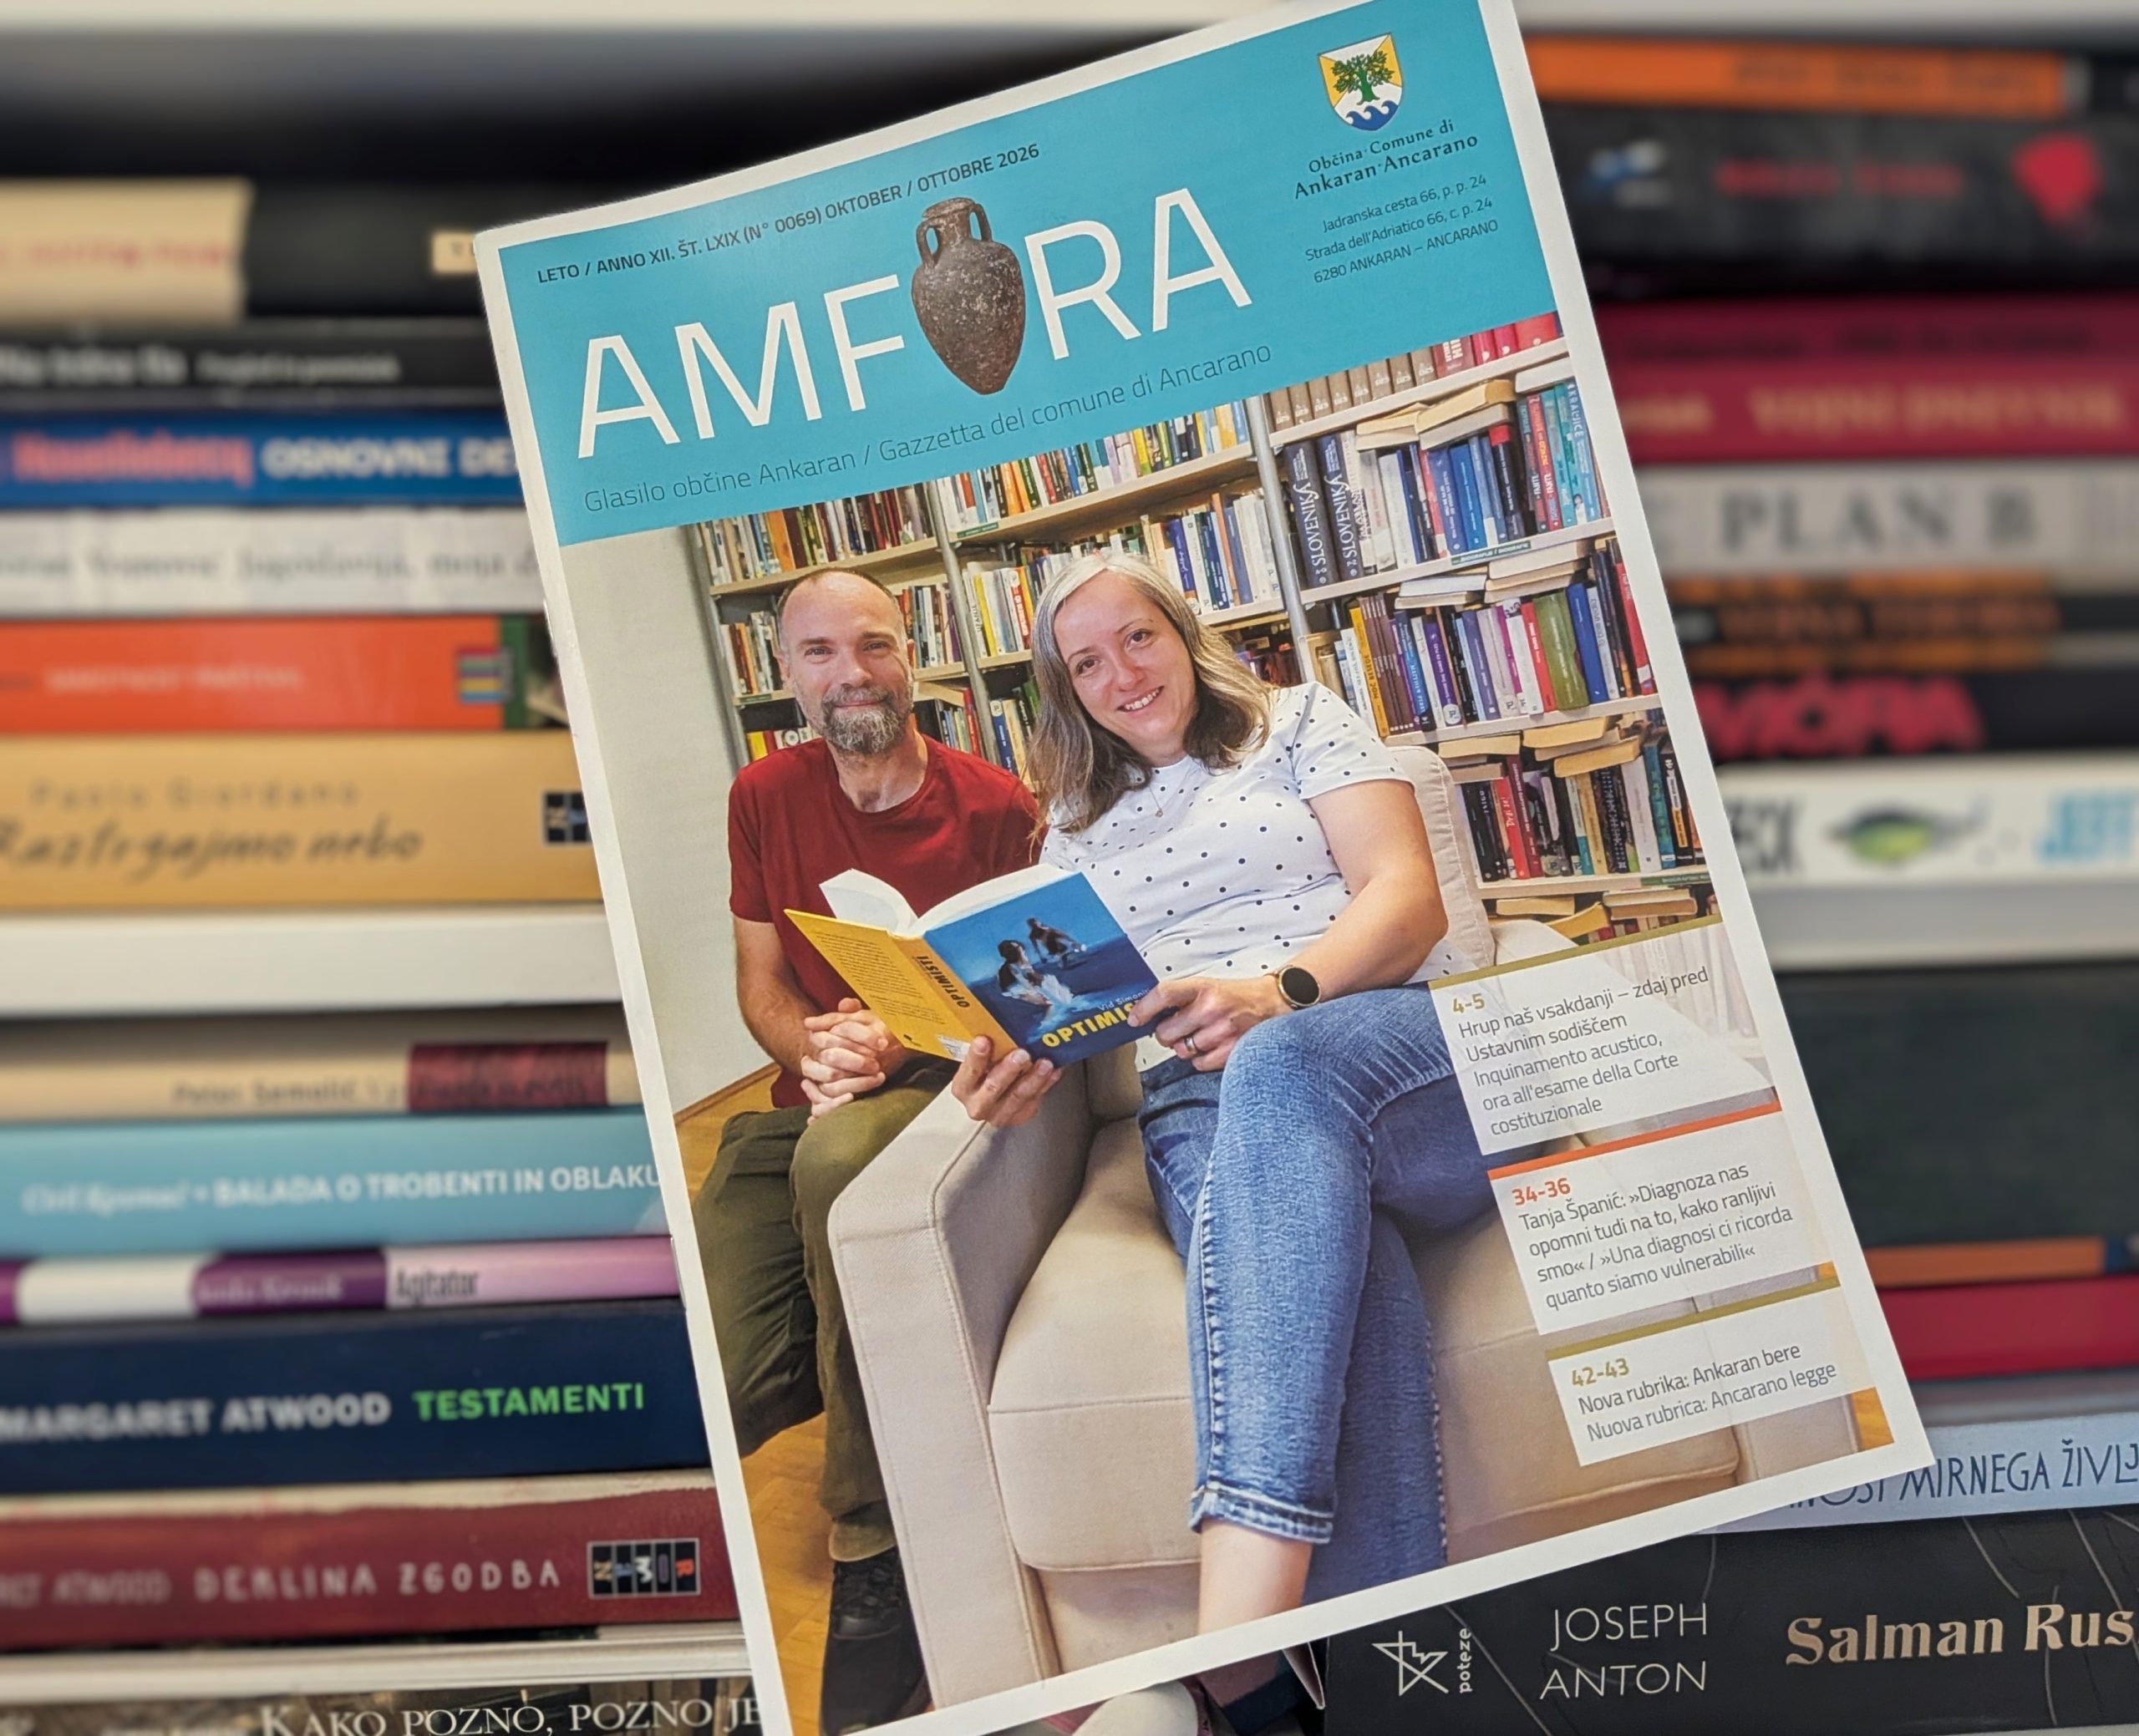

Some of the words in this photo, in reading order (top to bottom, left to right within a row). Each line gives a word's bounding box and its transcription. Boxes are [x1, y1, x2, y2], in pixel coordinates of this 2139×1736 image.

[1439, 119, 1455, 135] di
[537, 264, 580, 284] LETO
[585, 261, 592, 277] /
[597, 253, 646, 274] ANNO
[650, 247, 676, 265] XII.
[678, 239, 703, 258] ŠT.
[705, 231, 741, 252] LXIX
[775, 206, 822, 233] 0069)
[825, 185, 902, 220] OKTOBER
[907, 180, 913, 197] /
[917, 156, 995, 192] OTTOBRE
[998, 143, 1040, 168] 2026
[1304, 240, 1346, 261] Strada
[1348, 218, 1425, 250] dell'Adriatico
[1426, 211, 1448, 226] 66,
[1450, 208, 1461, 221] c.
[1461, 205, 1475, 219] p.
[1476, 196, 1493, 212] 24
[1323, 206, 1383, 233] Jadranska
[1385, 195, 1418, 215] cesta
[1420, 187, 1441, 203] 66,
[1442, 186, 1455, 201] p.
[1456, 182, 1469, 196] p.
[1469, 174, 1487, 189] 24
[1313, 264, 1347, 284] 6280
[1349, 244, 1412, 274] ANKARAN
[1426, 219, 1499, 251] ANCARANO
[578, 188, 1252, 459] AMFRA
[584, 482, 666, 512] Glasilo
[673, 470, 752, 499] občine
[759, 449, 856, 485] Ankaran
[864, 444, 871, 466] /
[879, 418, 986, 463] Gazzetta
[990, 407, 1026, 436] del
[1032, 385, 1125, 424] comune
[1131, 373, 1152, 399] di
[1160, 343, 1272, 393] Ancarano
[1293, 482, 1327, 566] SLOVENIKA
[1324, 474, 1358, 560] SLOVENIKA
[917, 955, 971, 1008] OPTIMISTI
[1452, 992, 1486, 1014] 4-5
[1458, 1017, 1501, 1039] Hrup
[1503, 1007, 1534, 1030] naš
[1537, 989, 1614, 1022] vsakdanji
[1633, 976, 1669, 999] zdaj
[1670, 966, 1710, 994] pred
[1041, 1002, 1135, 1048] OPTIMIS
[1465, 1031, 1547, 1063] Ustavnim
[1548, 1013, 1628, 1045] sodiščem
[1473, 1047, 1588, 1088] Inquinamento
[1590, 1033, 1664, 1060] acustico,
[1482, 1094, 1512, 1112] ora
[1513, 1075, 1590, 1105] all'esame
[1592, 1063, 1632, 1086] della
[1633, 1053, 1680, 1077] Corte
[1490, 1097, 1603, 1137] costituzionale
[214, 1175, 332, 1208] BALADA
[336, 1173, 363, 1202] O
[366, 1169, 505, 1201] TROBENTI
[513, 1169, 545, 1193] IN
[1512, 1177, 1572, 1206] 34-36
[1519, 1208, 1565, 1231] Tanja
[1565, 1191, 1627, 1222] Španić:
[1718, 1164, 1750, 1182] nas
[1529, 1231, 1593, 1261] opomni
[1594, 1221, 1628, 1242] tudi
[1630, 1216, 1653, 1233] na
[1654, 1210, 1678, 1229] to,
[1679, 1197, 1720, 1220] kako
[1721, 1180, 1776, 1211] ranljivi
[1589, 1251, 1595, 1271] /
[1648, 1224, 1716, 1256] diagnosi
[1719, 1220, 1732, 1238] ci
[1735, 1205, 1794, 1234] ricorda
[394, 1268, 482, 1305] Agitator
[1545, 1281, 1606, 1310] quanto
[1608, 1268, 1659, 1293] siamo
[1571, 1358, 1630, 1388] 42-43
[1578, 1391, 1623, 1415] Nova
[1626, 1373, 1689, 1404] rubrika:
[1692, 1356, 1760, 1387] Ankaran
[1762, 1343, 1802, 1367] bere
[0, 1398, 215, 1444] MARGARET
[221, 1391, 393, 1433] ATWOOD
[413, 1383, 646, 1421] TESTAMENTI
[1587, 1414, 1644, 1442] Nuova
[1646, 1398, 1709, 1428] rubrica:
[1710, 1377, 1789, 1410] Ancarano
[1790, 1363, 1838, 1390] legge
[1898, 1450, 2050, 1502] MIRNEGA
[192, 1562, 379, 1603] DEKLINA
[398, 1558, 561, 1596] ZGODBA
[1549, 1603, 1709, 1652] JOSEPH
[1785, 1613, 2004, 1667] Salman
[1457, 1627, 1474, 1695] poteze
[1539, 1661, 1708, 1701] ANTON
[401, 1705, 555, 1736] POZNO,
[568, 1698, 714, 1733] POZNO
